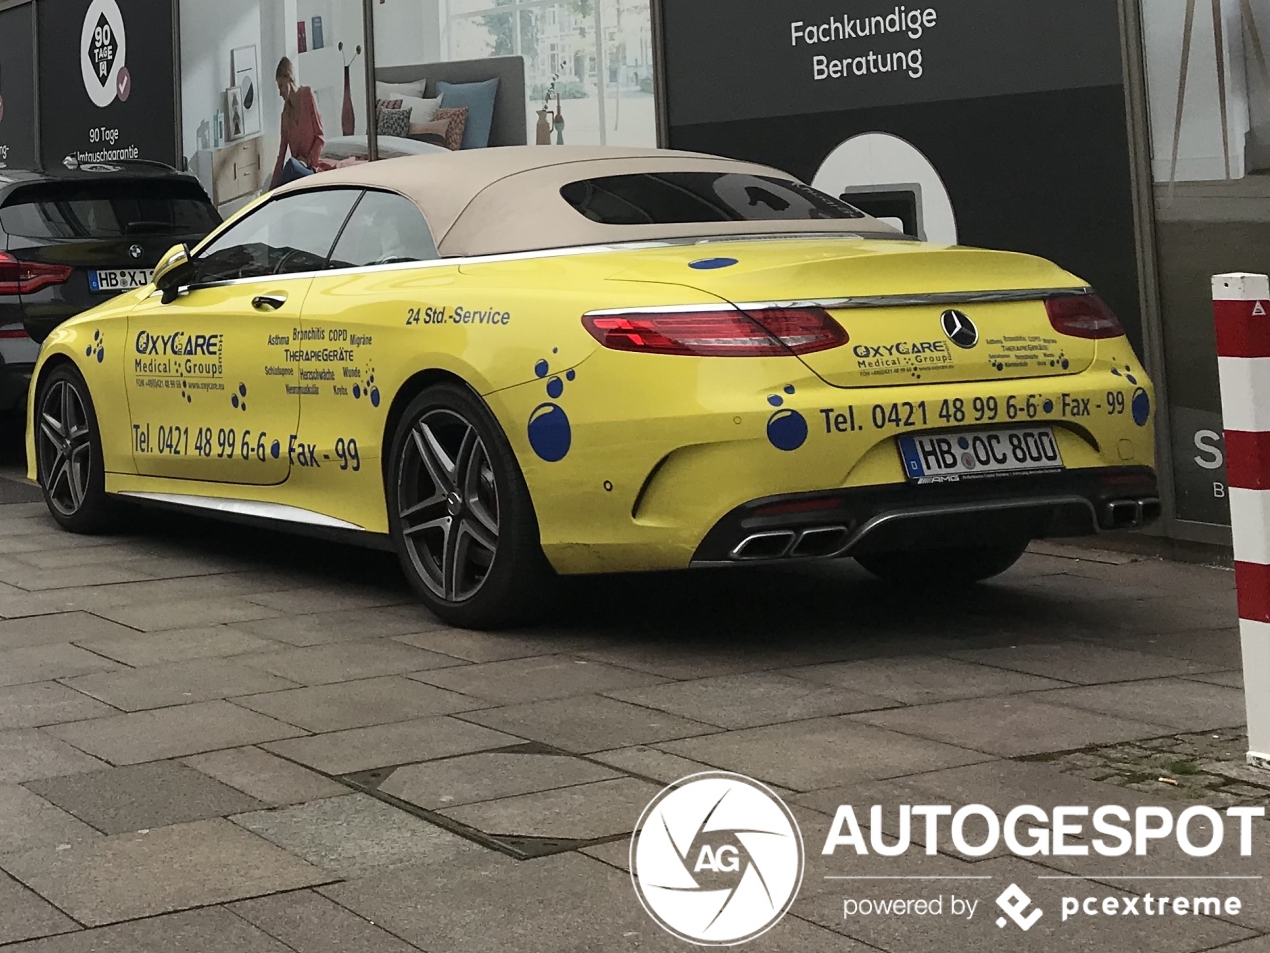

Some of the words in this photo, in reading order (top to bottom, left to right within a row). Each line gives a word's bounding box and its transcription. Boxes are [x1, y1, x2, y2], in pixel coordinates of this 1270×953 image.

[790, 3, 938, 47] Fachkundige
[94, 24, 111, 48] 90
[93, 45, 113, 63] TAGE
[812, 44, 924, 80] Beratung
[89, 128, 100, 143] 90
[101, 126, 119, 145] Tage
[98, 271, 119, 287] HB
[127, 270, 148, 287] XJ
[406, 307, 421, 326] 24
[423, 305, 511, 326] Std.-Service
[267, 334, 290, 346] Asthma
[292, 327, 325, 341] Bronchitis
[328, 329, 348, 342] COPD
[349, 334, 372, 348] Migräne
[134, 358, 171, 374] Medical
[184, 358, 218, 378] Group
[857, 357, 901, 369] Medical
[915, 354, 948, 364] Group
[820, 404, 863, 434] Tel.
[872, 400, 928, 428] 0421
[938, 398, 966, 422] 48
[973, 395, 998, 420] 99
[1006, 395, 1037, 419] 6-6
[1060, 392, 1090, 417] Fax
[1106, 391, 1125, 415] 99
[133, 423, 154, 454] Tel.
[157, 425, 189, 457] 0421
[194, 426, 213, 458] 48
[217, 428, 236, 459] 99
[241, 430, 267, 463] 6-6
[288, 434, 321, 468] Fax
[335, 437, 361, 472] 99
[918, 438, 958, 470] HB
[972, 434, 1008, 466] OC
[1009, 431, 1058, 463] 800
